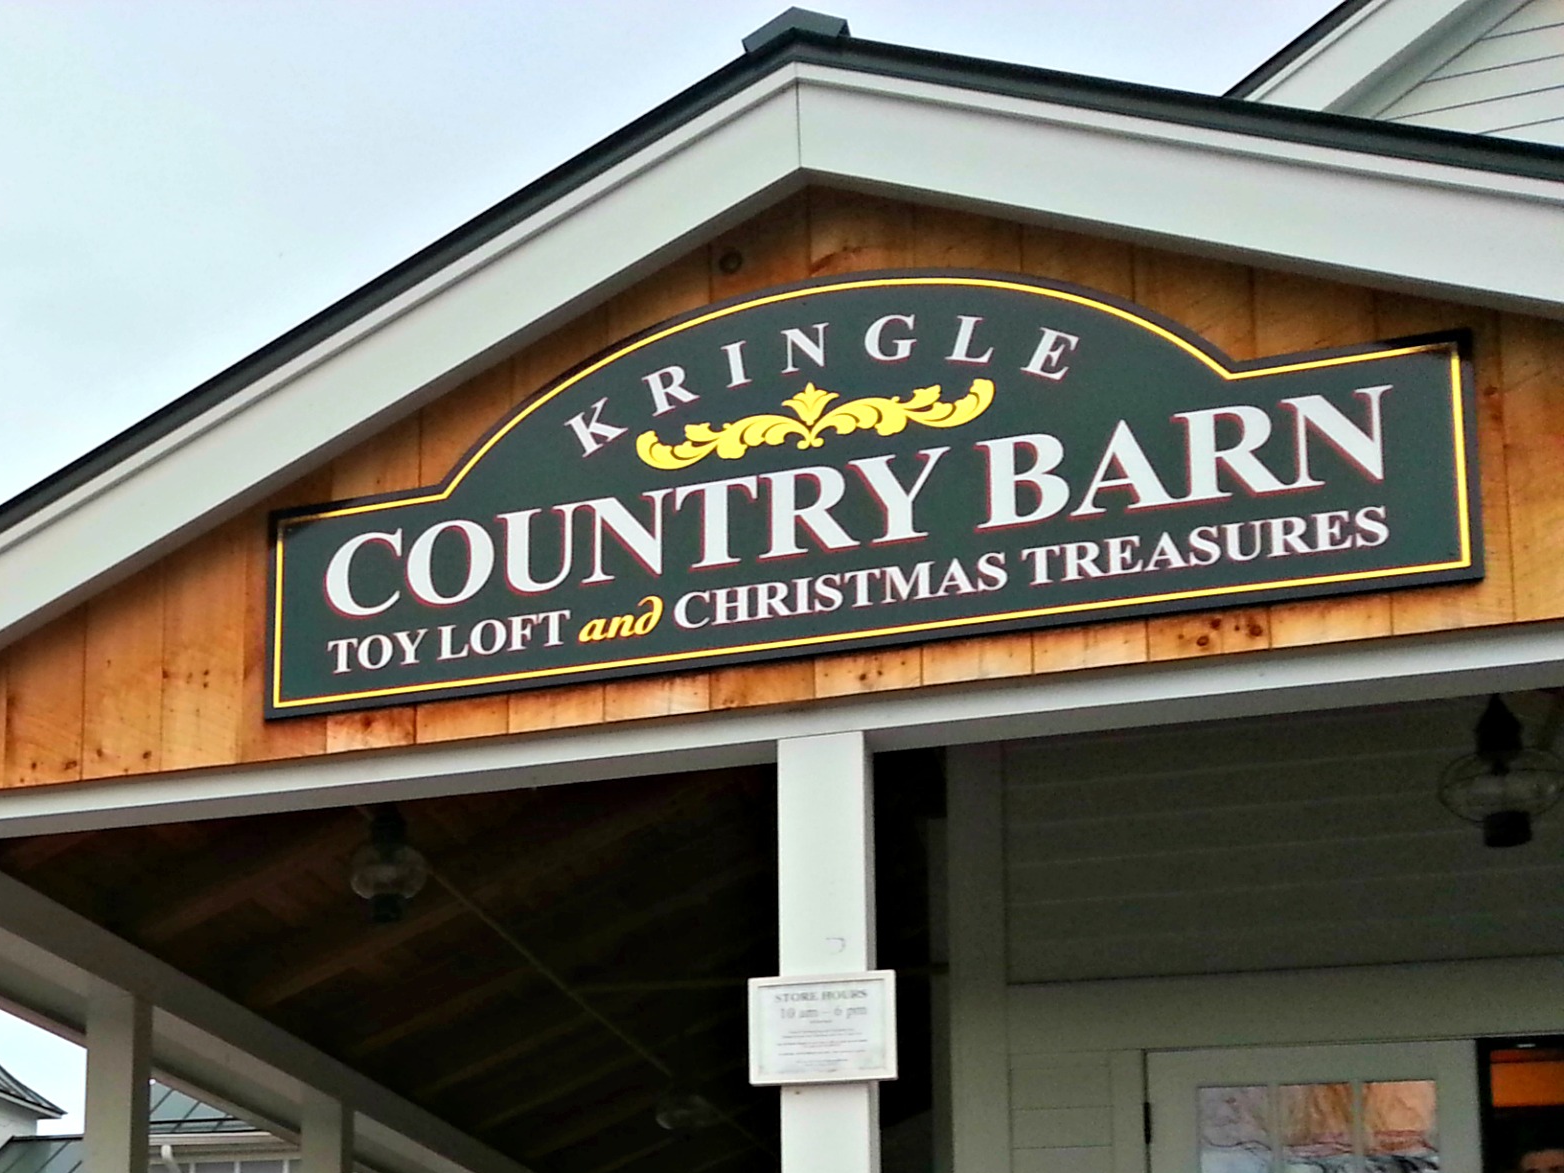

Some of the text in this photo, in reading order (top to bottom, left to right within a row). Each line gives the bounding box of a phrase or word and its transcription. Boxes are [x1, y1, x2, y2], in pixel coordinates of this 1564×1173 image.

[566, 314, 1079, 458] KRINGLE
[324, 384, 1393, 618] COUNTRY BARN
[328, 506, 1390, 674] TOY LOFT and CHRISTMAS TREASURES
